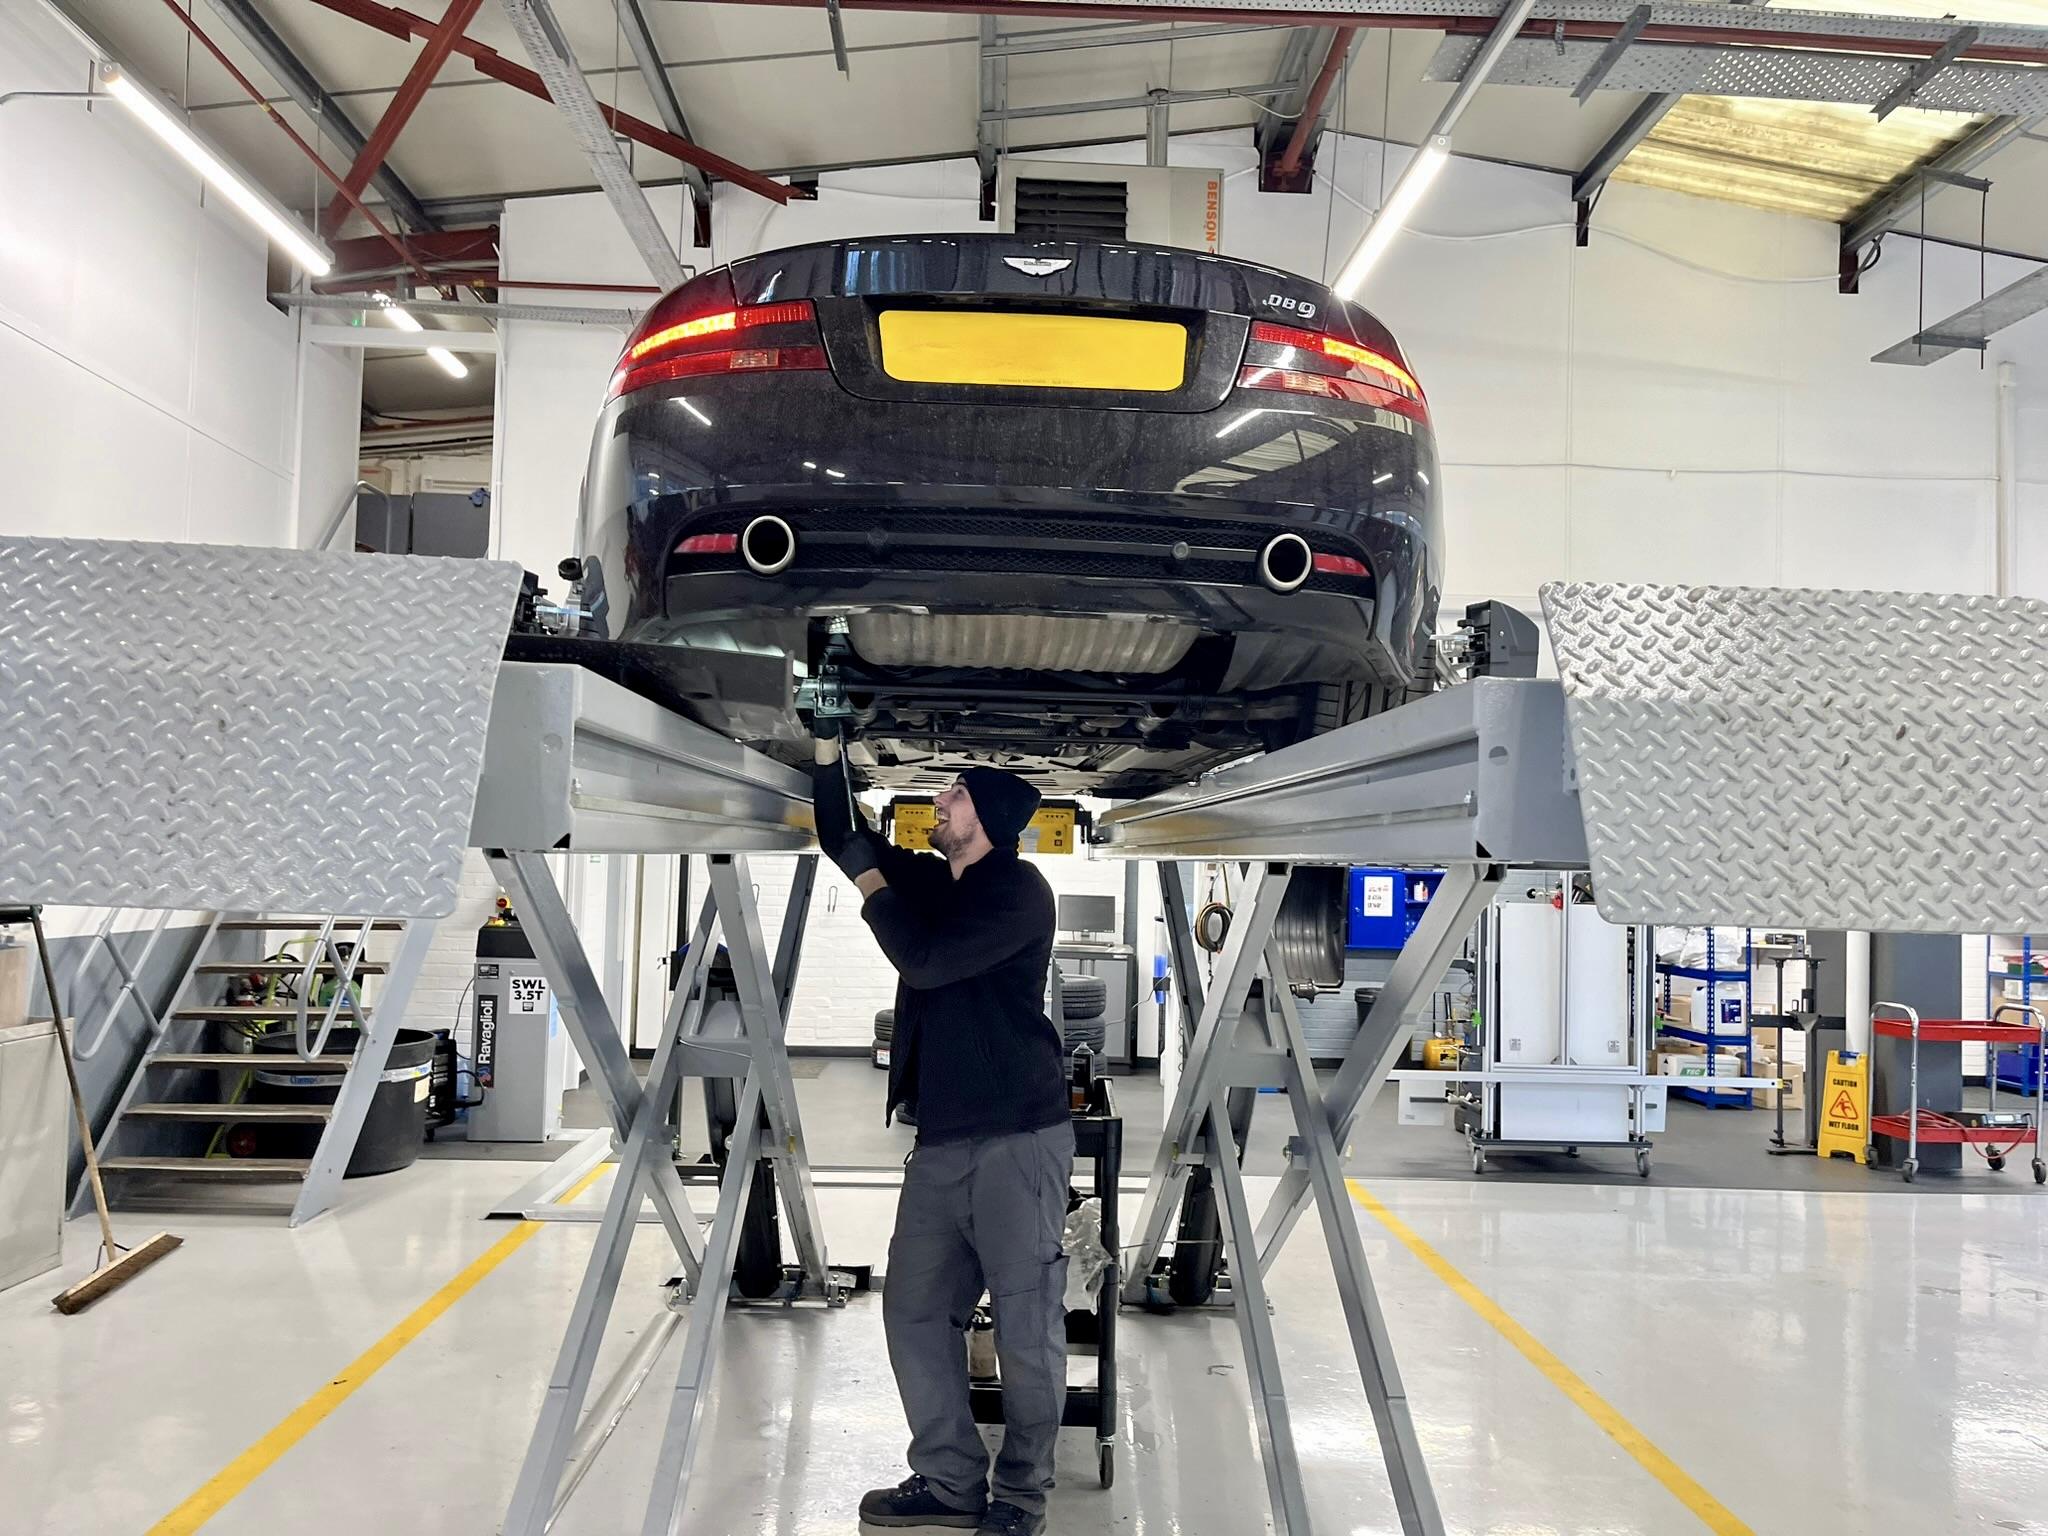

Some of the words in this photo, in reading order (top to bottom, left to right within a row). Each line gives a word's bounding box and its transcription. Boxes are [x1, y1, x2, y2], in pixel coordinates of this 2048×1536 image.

[1206, 181, 1218, 241] BENSON
[1267, 294, 1317, 319] DB9
[511, 979, 546, 990] SWL
[513, 990, 544, 1001] 3.5T
[478, 1000, 496, 1065] Ravaglioli
[1832, 1078, 1858, 1088] CAUTION
[1828, 1120, 1841, 1129] WET
[1841, 1122, 1860, 1131] FLOOR
